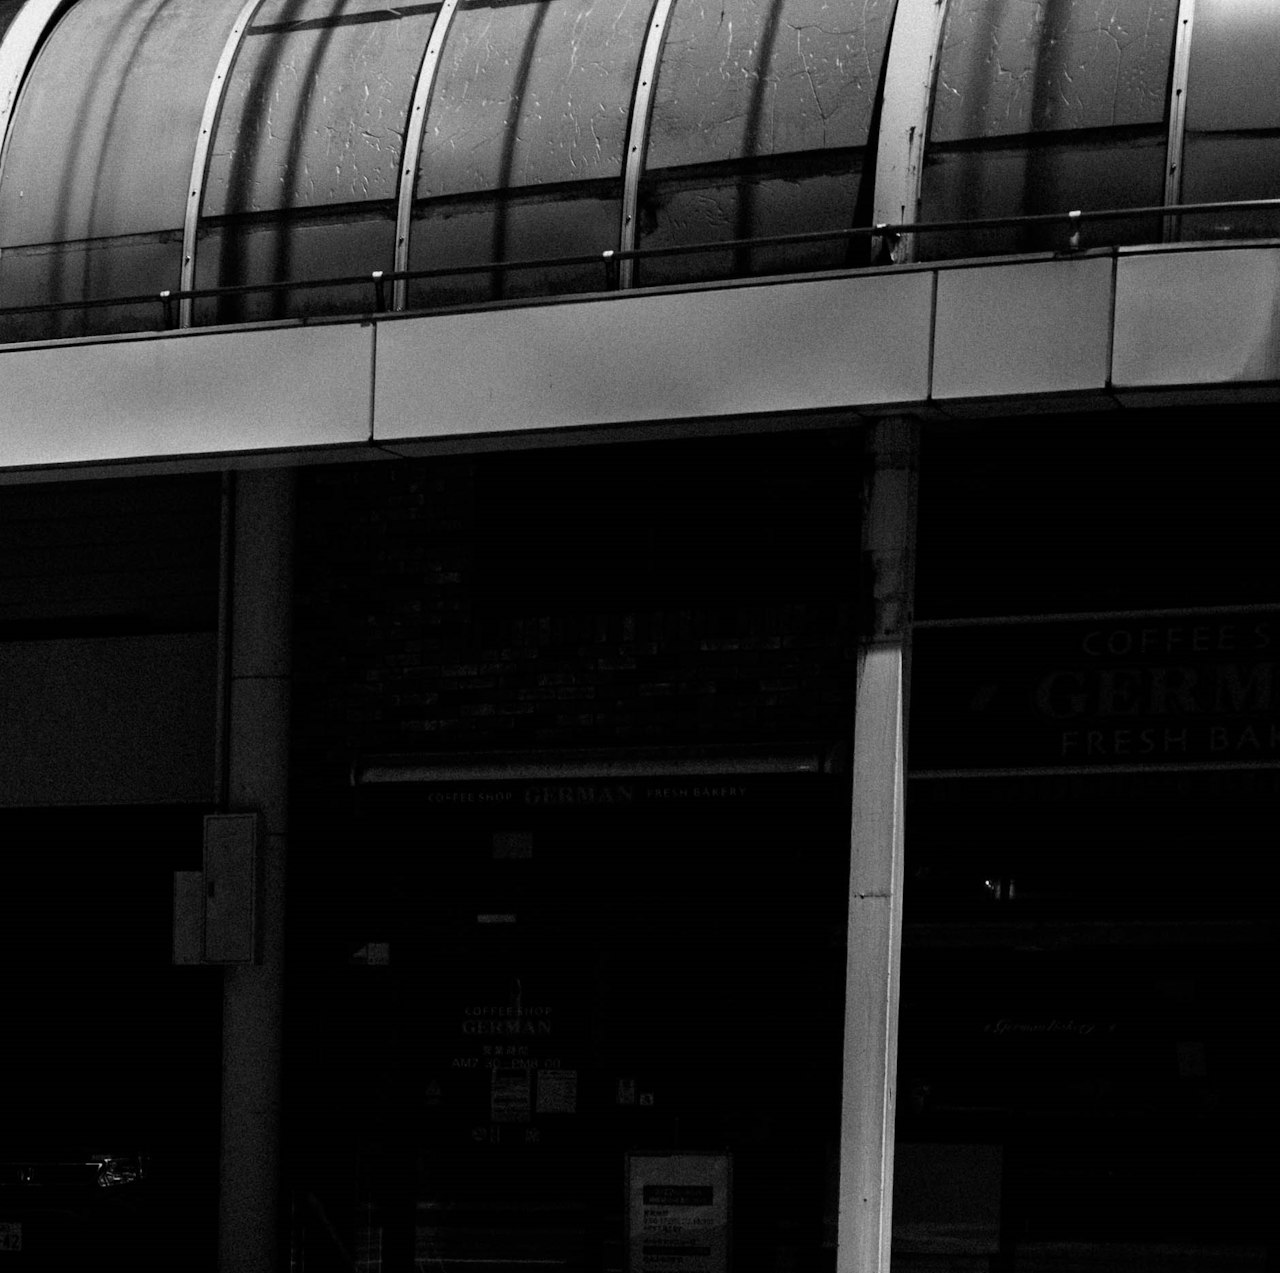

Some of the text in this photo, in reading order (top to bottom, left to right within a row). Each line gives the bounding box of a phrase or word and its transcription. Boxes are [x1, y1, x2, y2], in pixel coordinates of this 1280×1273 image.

[1080, 623, 1236, 656] COFFEE
[1060, 727, 1188, 757] FRESH
[427, 784, 747, 806] COFFEE SHOP GERMAN FRESH BAKERY
[464, 1006, 553, 1017] COFFEE SHOP
[461, 1019, 552, 1034] GERMAN
